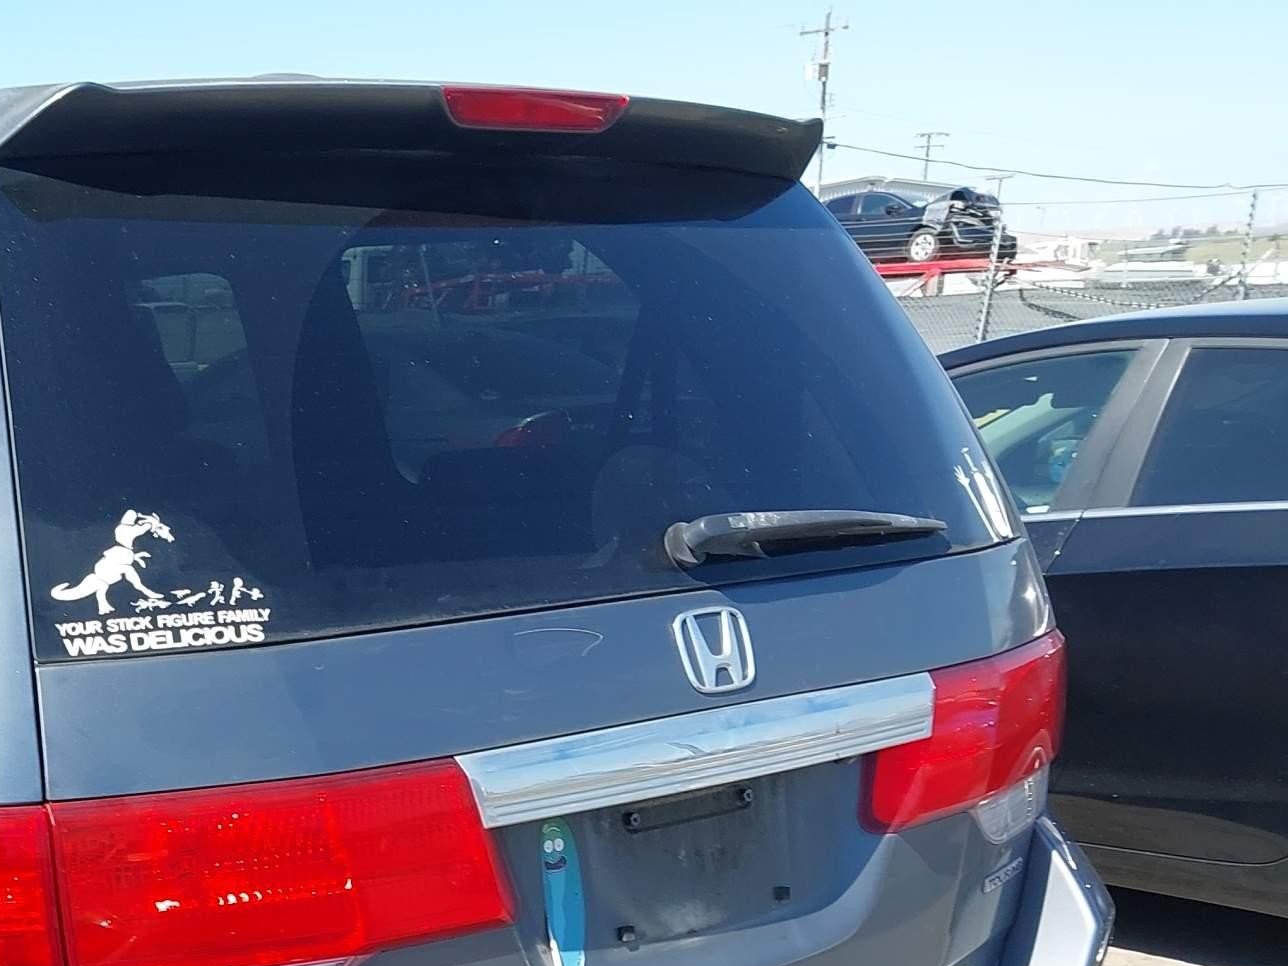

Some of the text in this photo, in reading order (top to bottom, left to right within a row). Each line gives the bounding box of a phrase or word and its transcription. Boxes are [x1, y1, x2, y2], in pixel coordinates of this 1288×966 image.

[54, 608, 270, 637] YOUR STICK FIGURE FAMILY
[62, 623, 265, 656] WAS DELICIOUS
